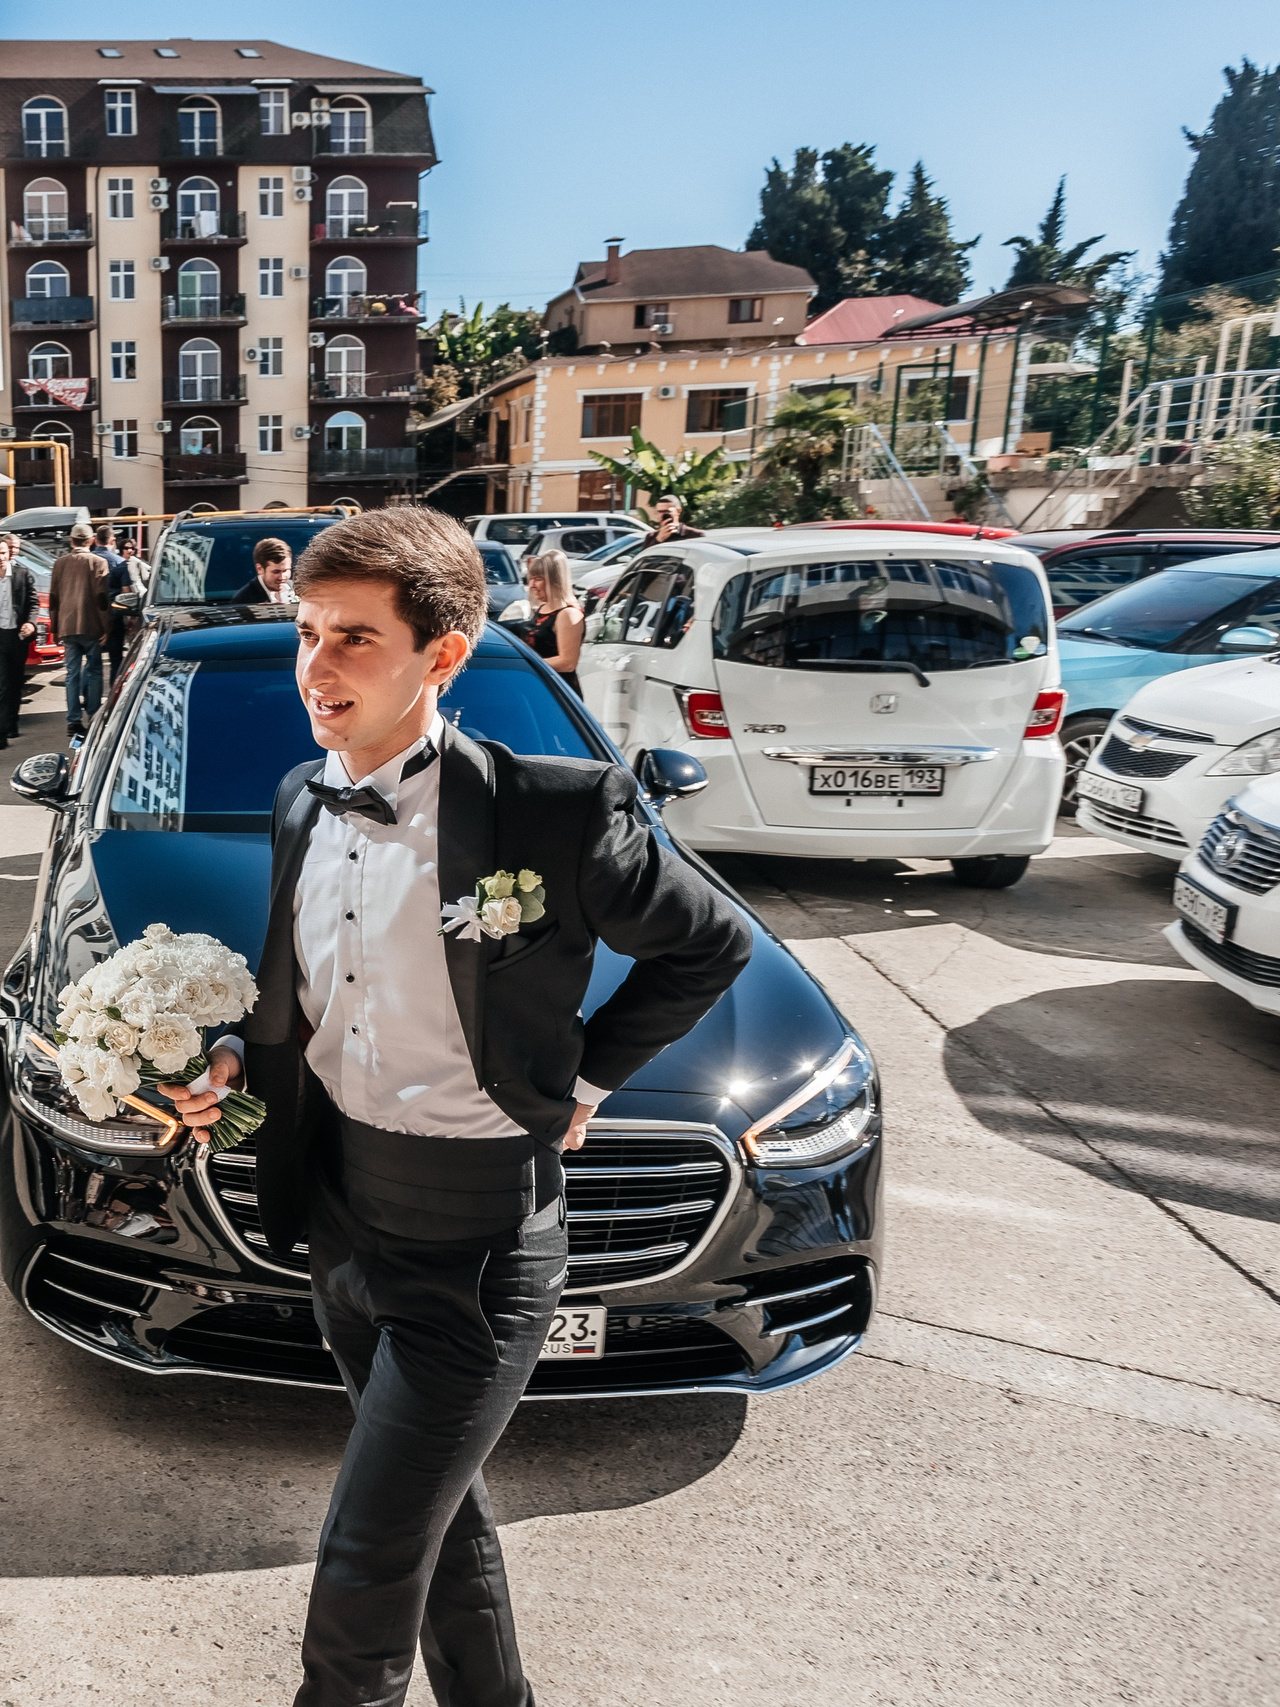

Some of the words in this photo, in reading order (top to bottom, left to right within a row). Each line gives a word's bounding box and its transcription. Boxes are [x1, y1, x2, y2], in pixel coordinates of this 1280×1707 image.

[820, 770, 900, 788] Х016ВЕ
[905, 769, 937, 784] 193
[547, 1313, 590, 1342] 23
[542, 1343, 571, 1354] RUS
